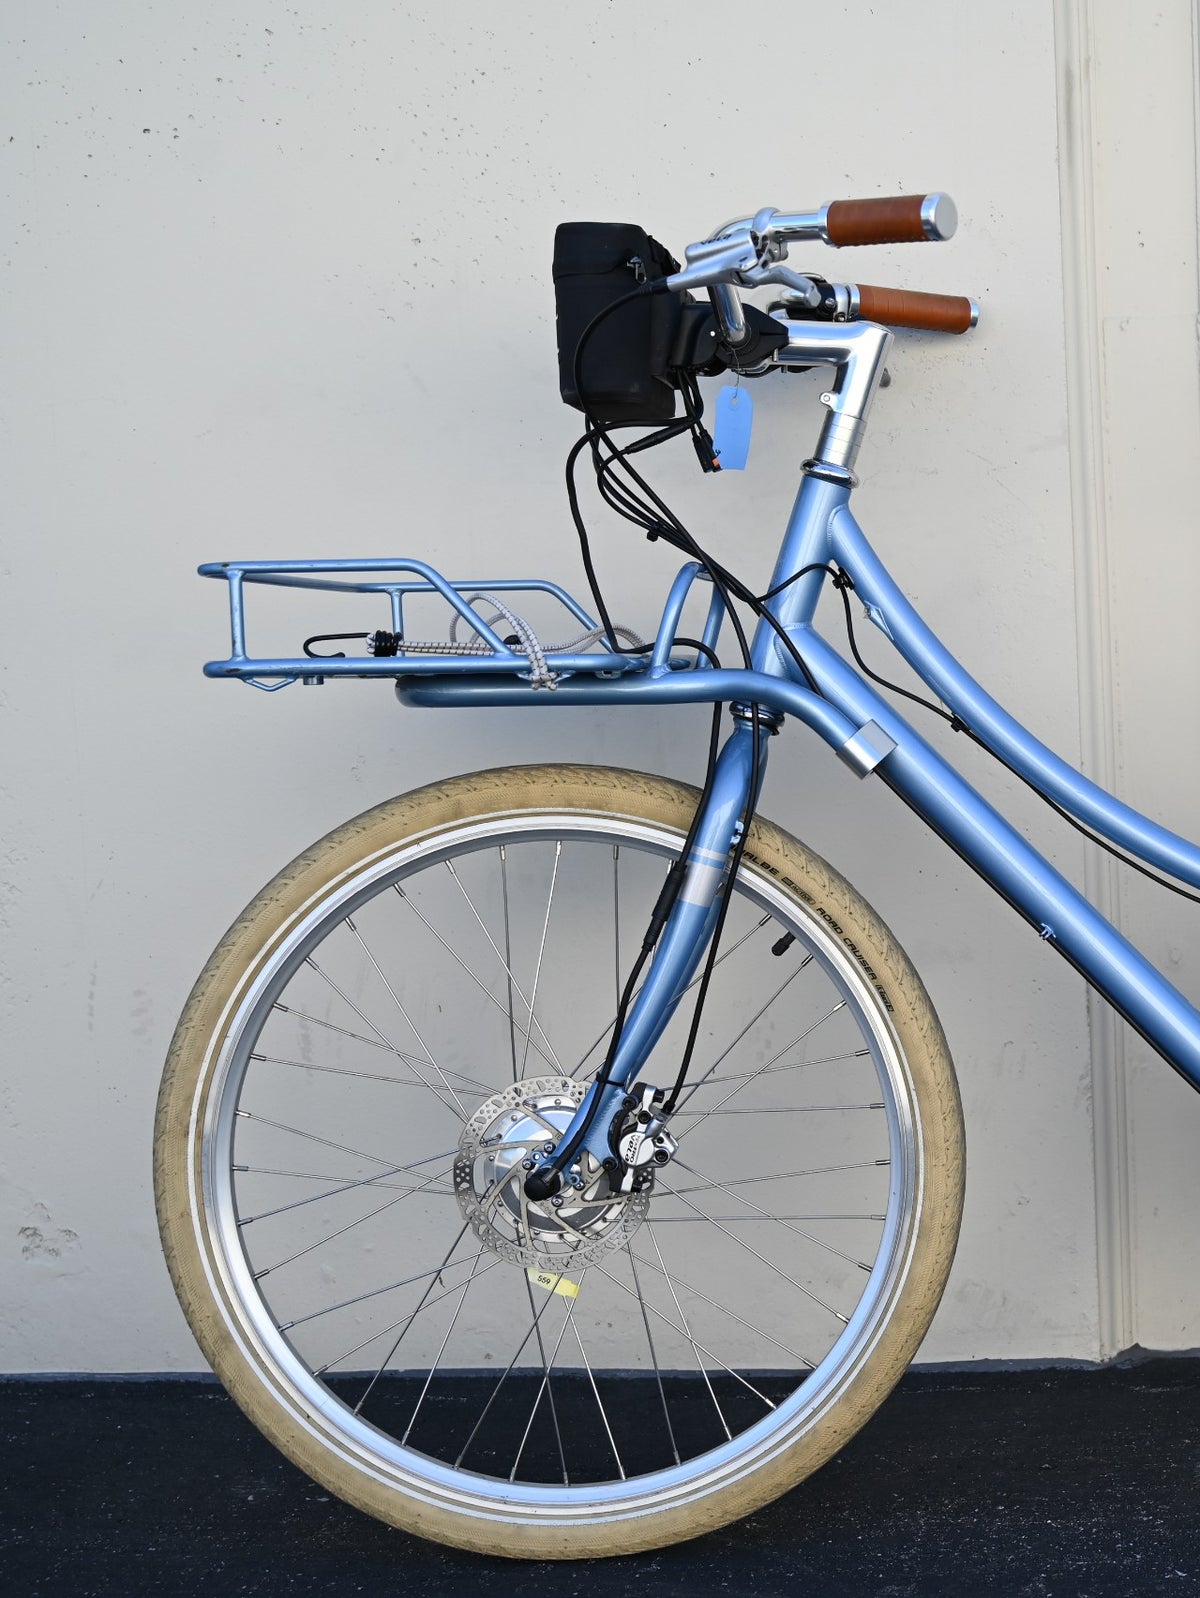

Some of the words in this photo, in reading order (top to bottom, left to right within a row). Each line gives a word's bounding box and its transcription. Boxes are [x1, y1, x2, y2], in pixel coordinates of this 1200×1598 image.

[743, 850, 780, 876] ALBE
[816, 907, 844, 935] ROAD
[842, 937, 878, 981] CRUISER
[537, 1275, 551, 1285] 559
